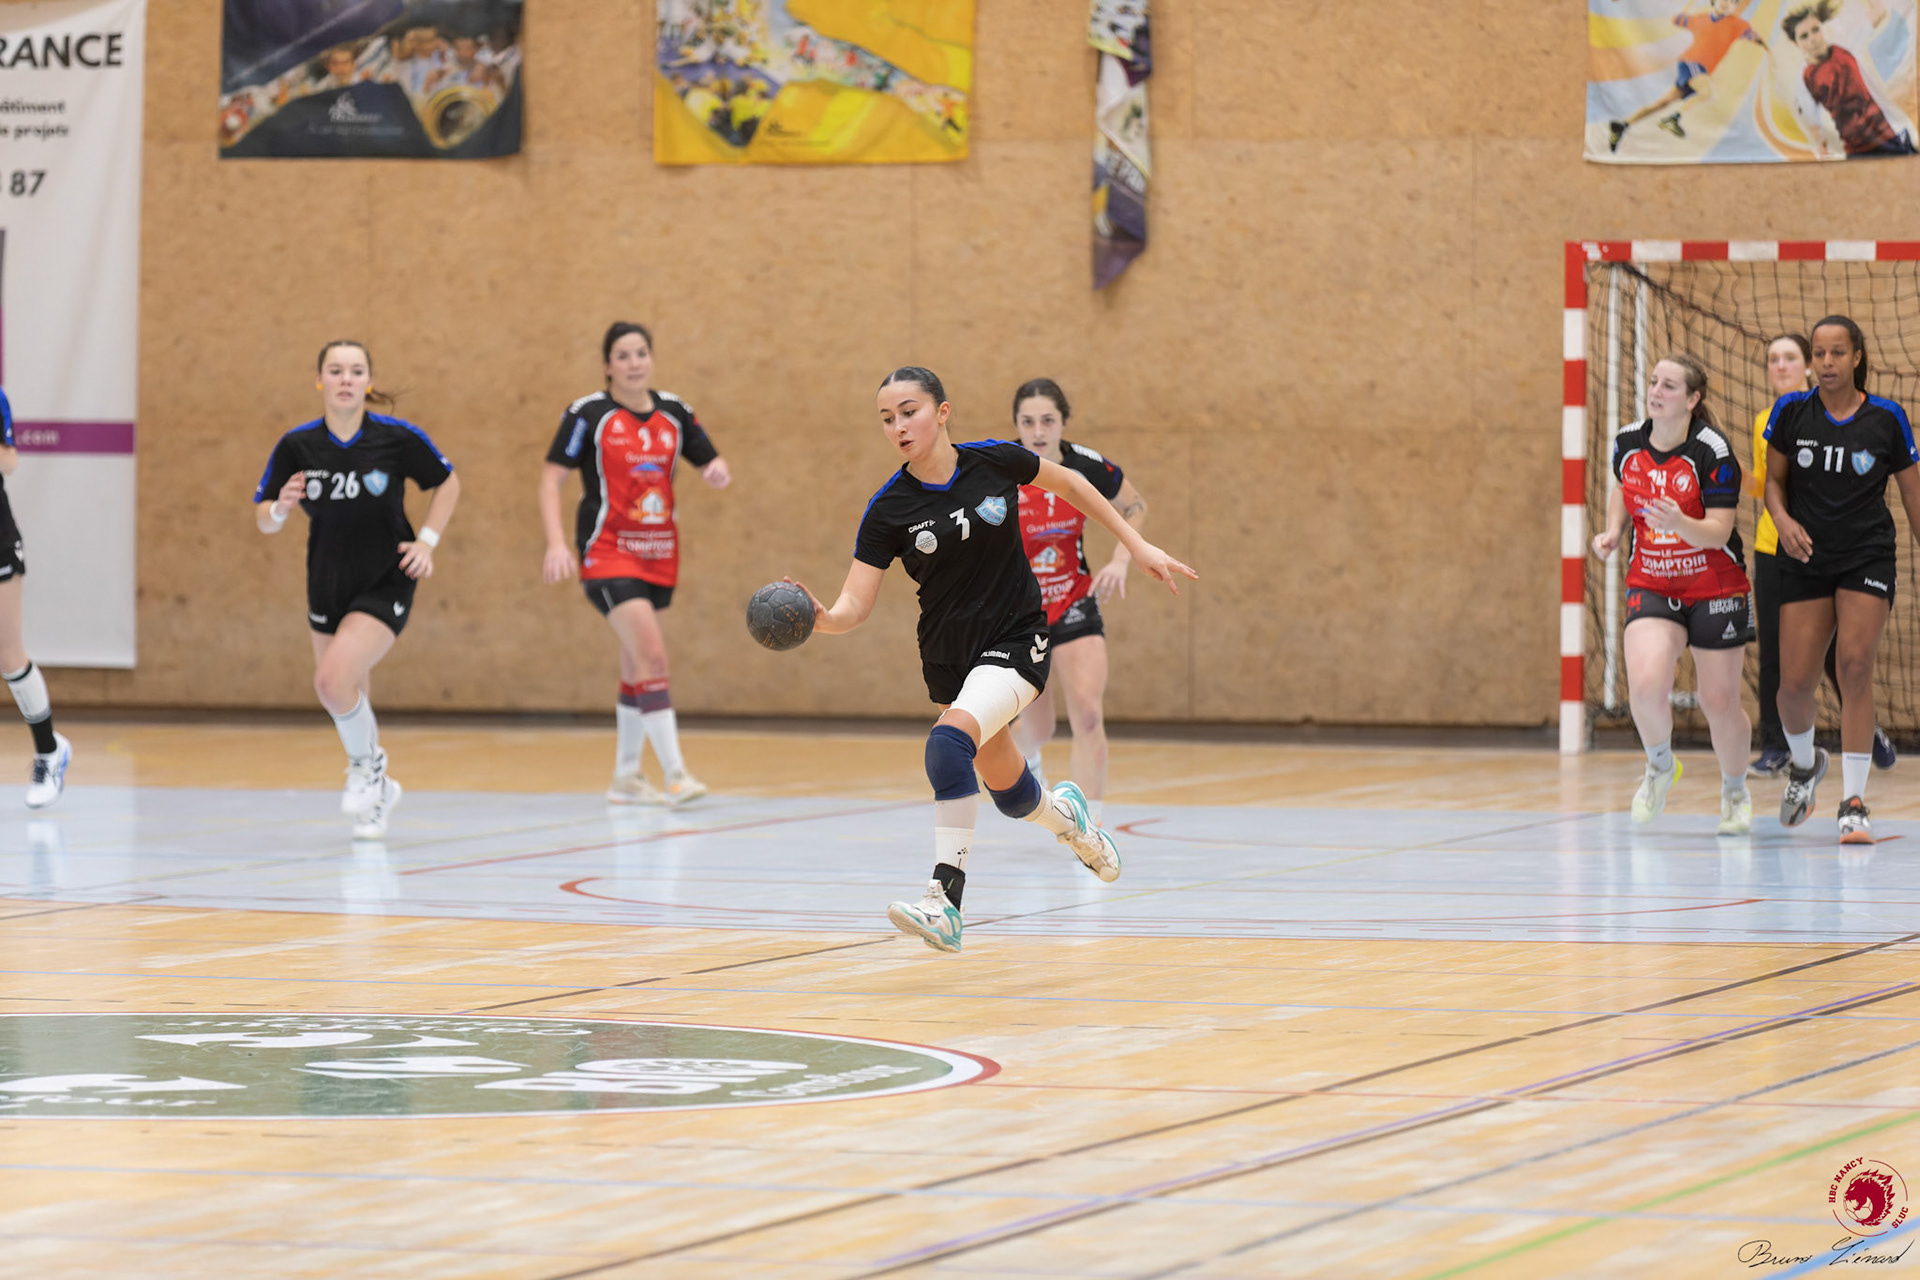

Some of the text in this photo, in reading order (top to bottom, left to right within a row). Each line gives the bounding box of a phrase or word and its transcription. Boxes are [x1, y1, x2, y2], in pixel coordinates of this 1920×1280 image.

[0, 100, 65, 114] âtiment
[11, 171, 46, 197] 87
[1823, 445, 1844, 473] 11
[329, 470, 361, 500] 26
[1647, 469, 1667, 496] 14
[908, 520, 929, 534] CRAFT
[949, 507, 970, 541] 3
[1661, 548, 1671, 557] LE
